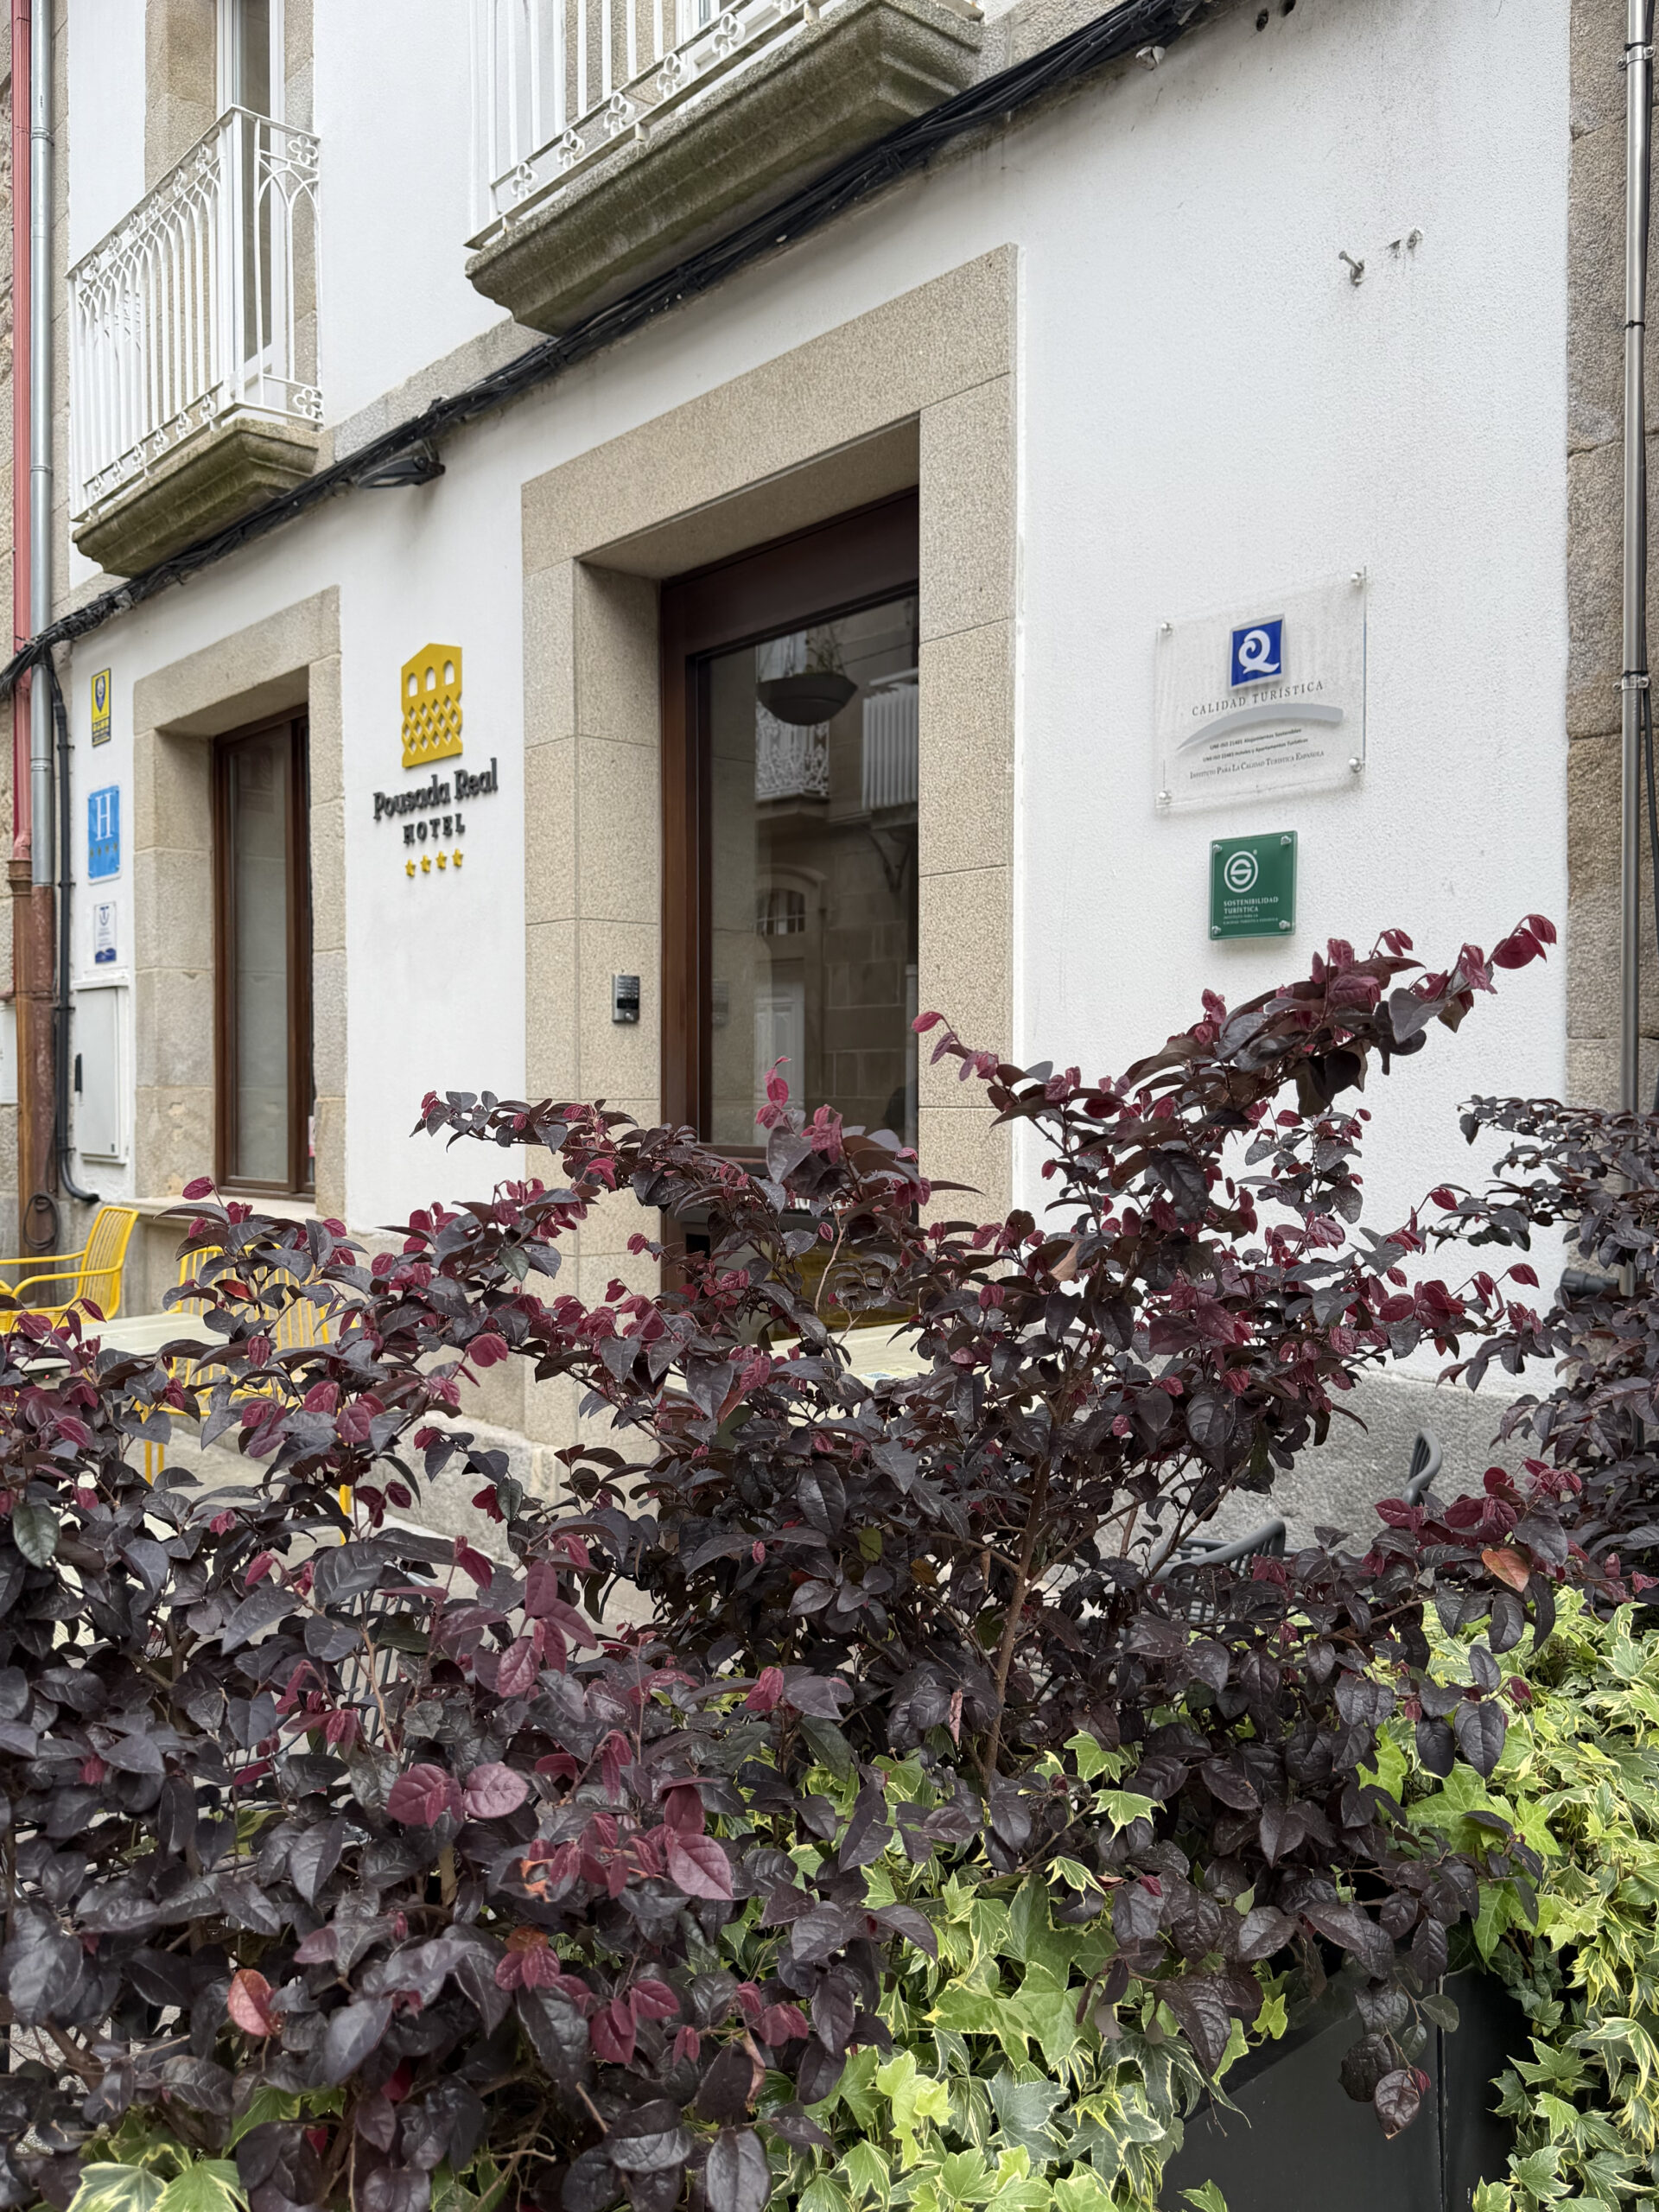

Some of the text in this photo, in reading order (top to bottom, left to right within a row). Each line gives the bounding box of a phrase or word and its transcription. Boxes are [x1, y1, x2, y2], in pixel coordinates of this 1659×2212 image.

[1238, 629, 1280, 674] Q
[1192, 680, 1324, 716] CALIDAD TURÍSTICA
[373, 757, 499, 821] Pousada Real
[95, 792, 113, 842] H
[403, 813, 466, 844] HOTEL
[1224, 896, 1279, 907] SOSTENIBILIDAD
